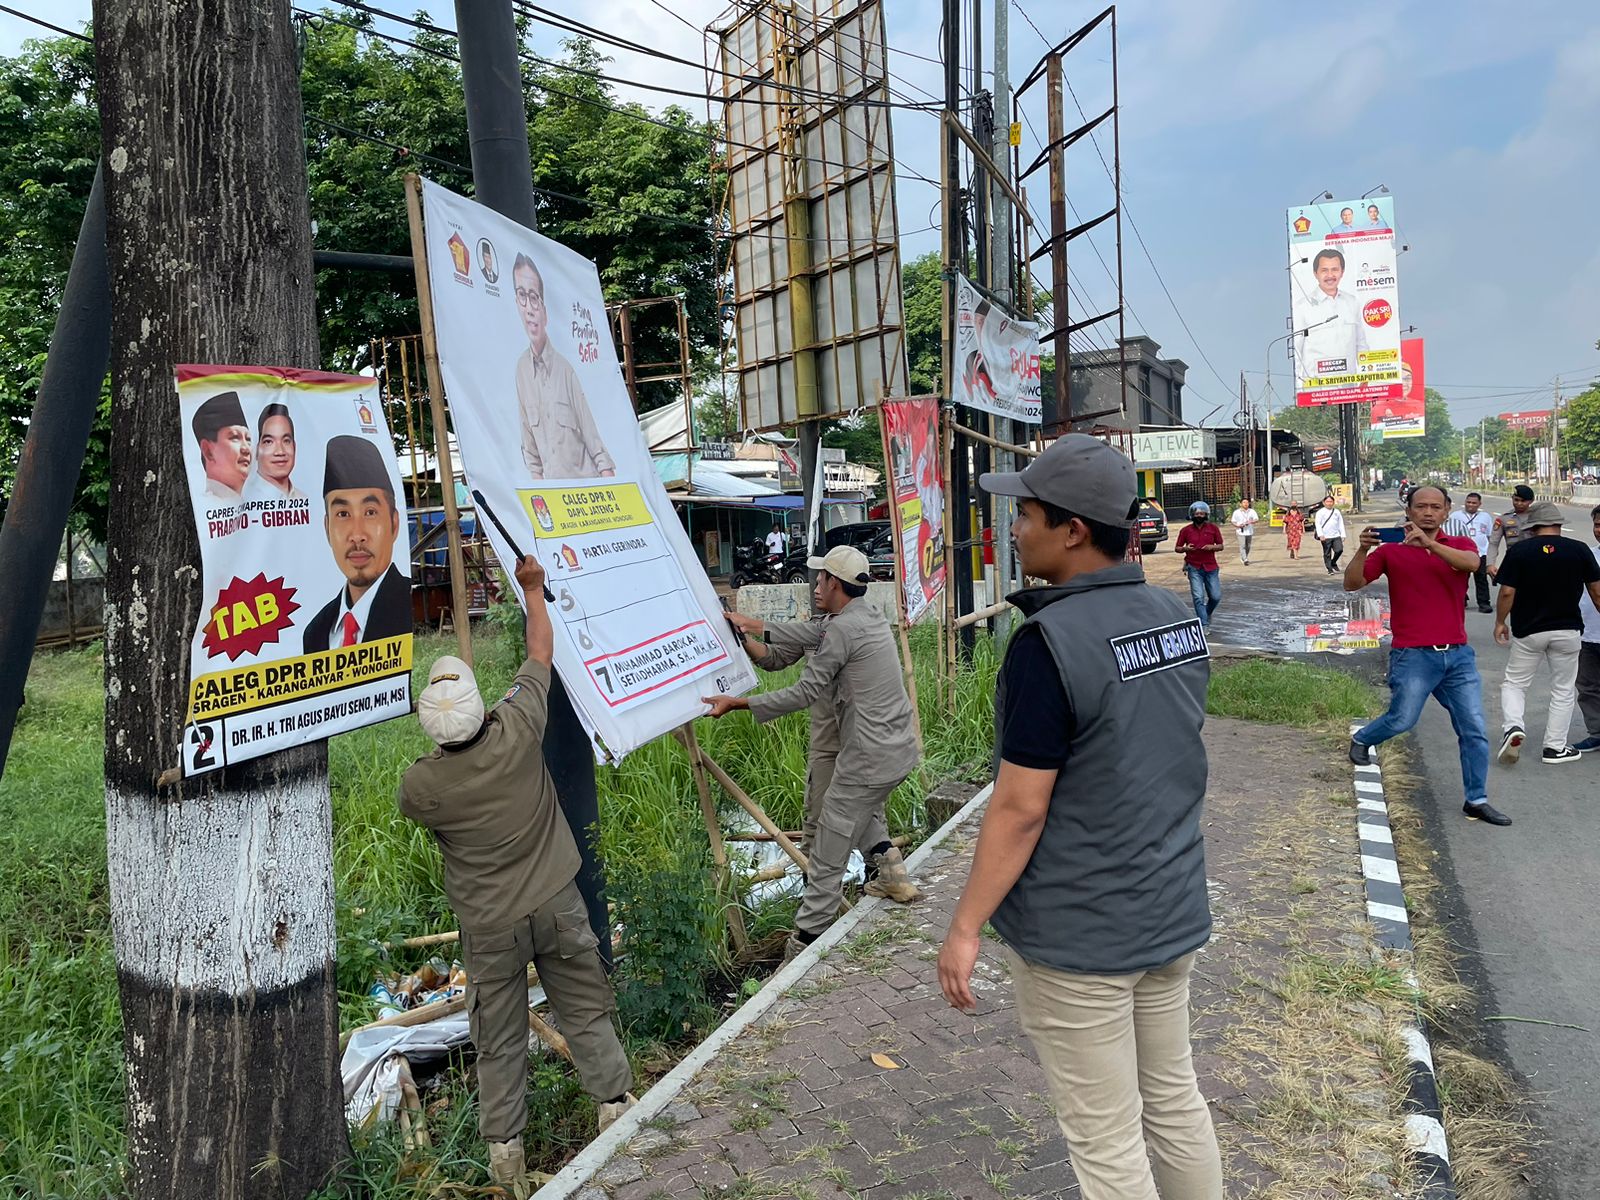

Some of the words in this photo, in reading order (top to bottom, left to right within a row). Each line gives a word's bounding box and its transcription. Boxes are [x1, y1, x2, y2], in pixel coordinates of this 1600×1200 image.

[1365, 307, 1379, 316] PAK
[1366, 313, 1381, 323] DPR
[572, 321, 599, 345] Penting
[578, 341, 598, 363] Setia
[1325, 376, 1355, 385] SRIYANTO
[1157, 433, 1199, 451] TEWE
[206, 506, 234, 520] CAPRES
[278, 499, 287, 509] RI
[289, 498, 309, 509] 2024
[562, 492, 588, 505] CALEG
[589, 491, 606, 503] DPR
[607, 491, 616, 501] RI
[261, 509, 310, 528] GIBRAN
[567, 506, 588, 518] DAPIL
[589, 504, 615, 515] JATENG
[615, 503, 620, 512] 4
[552, 552, 564, 569] 2
[582, 545, 612, 559] PARTAI
[613, 538, 648, 553] GERINDRA
[560, 588, 575, 612] 5
[213, 592, 280, 641] TAB
[578, 629, 594, 651] 6
[594, 666, 614, 694] 7
[614, 648, 663, 675] MUHAMMAD
[661, 632, 698, 656] BAROKAH
[1115, 636, 1160, 673] BAWASLU
[194, 671, 259, 701] CALEG
[265, 661, 307, 686] DPR
[312, 656, 331, 676] RI
[335, 646, 383, 671] DAPIL
[387, 641, 402, 659] IV
[192, 692, 247, 714] SRAGEN
[257, 671, 344, 700] KARANGANYAR
[352, 657, 402, 678] WONOGIRI
[191, 725, 215, 770] 2
[231, 729, 251, 747] DR.
[252, 725, 266, 742] IR.
[267, 721, 278, 736] H.
[279, 715, 296, 733] TRI
[297, 709, 323, 730] AGUS
[323, 703, 347, 724] BAYU
[348, 697, 374, 715] SENO,
[373, 692, 389, 709] MH,
[390, 687, 406, 704] MSi
